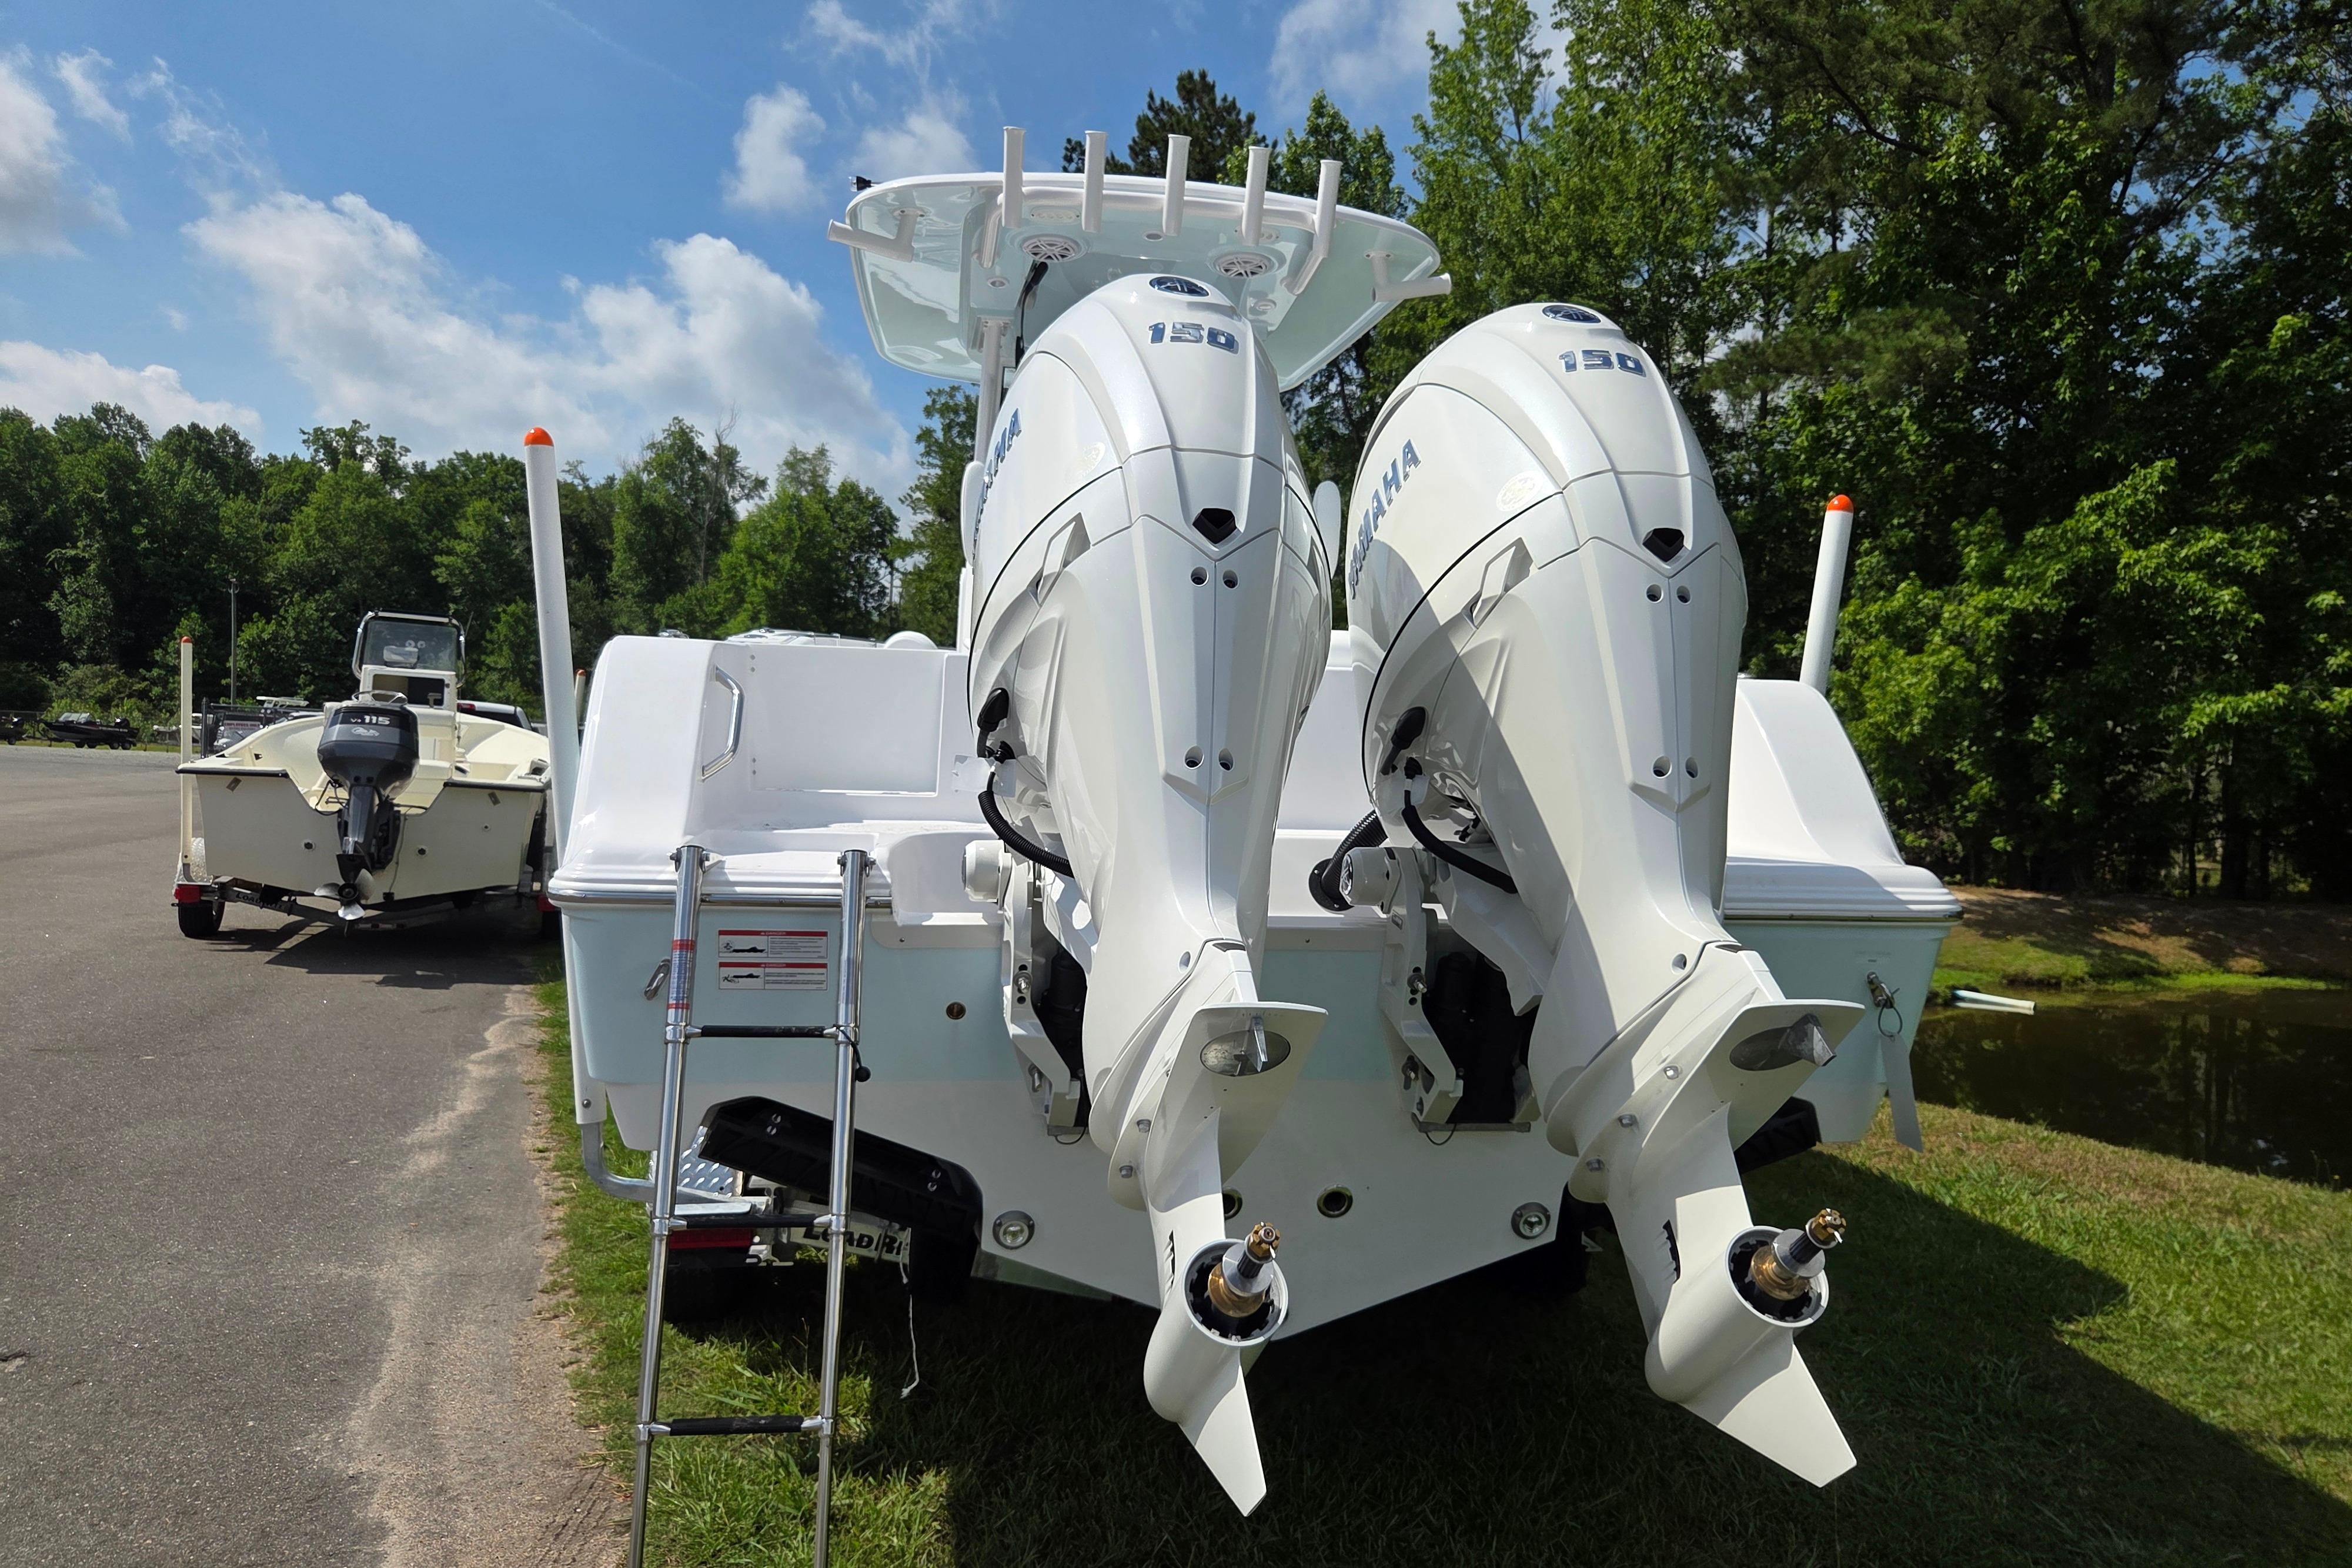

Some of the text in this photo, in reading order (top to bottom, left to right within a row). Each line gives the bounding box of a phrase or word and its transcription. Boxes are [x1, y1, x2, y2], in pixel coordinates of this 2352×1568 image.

[1148, 322, 1240, 355] 150
[1559, 349, 1647, 377] 150
[364, 716, 390, 725] 115
